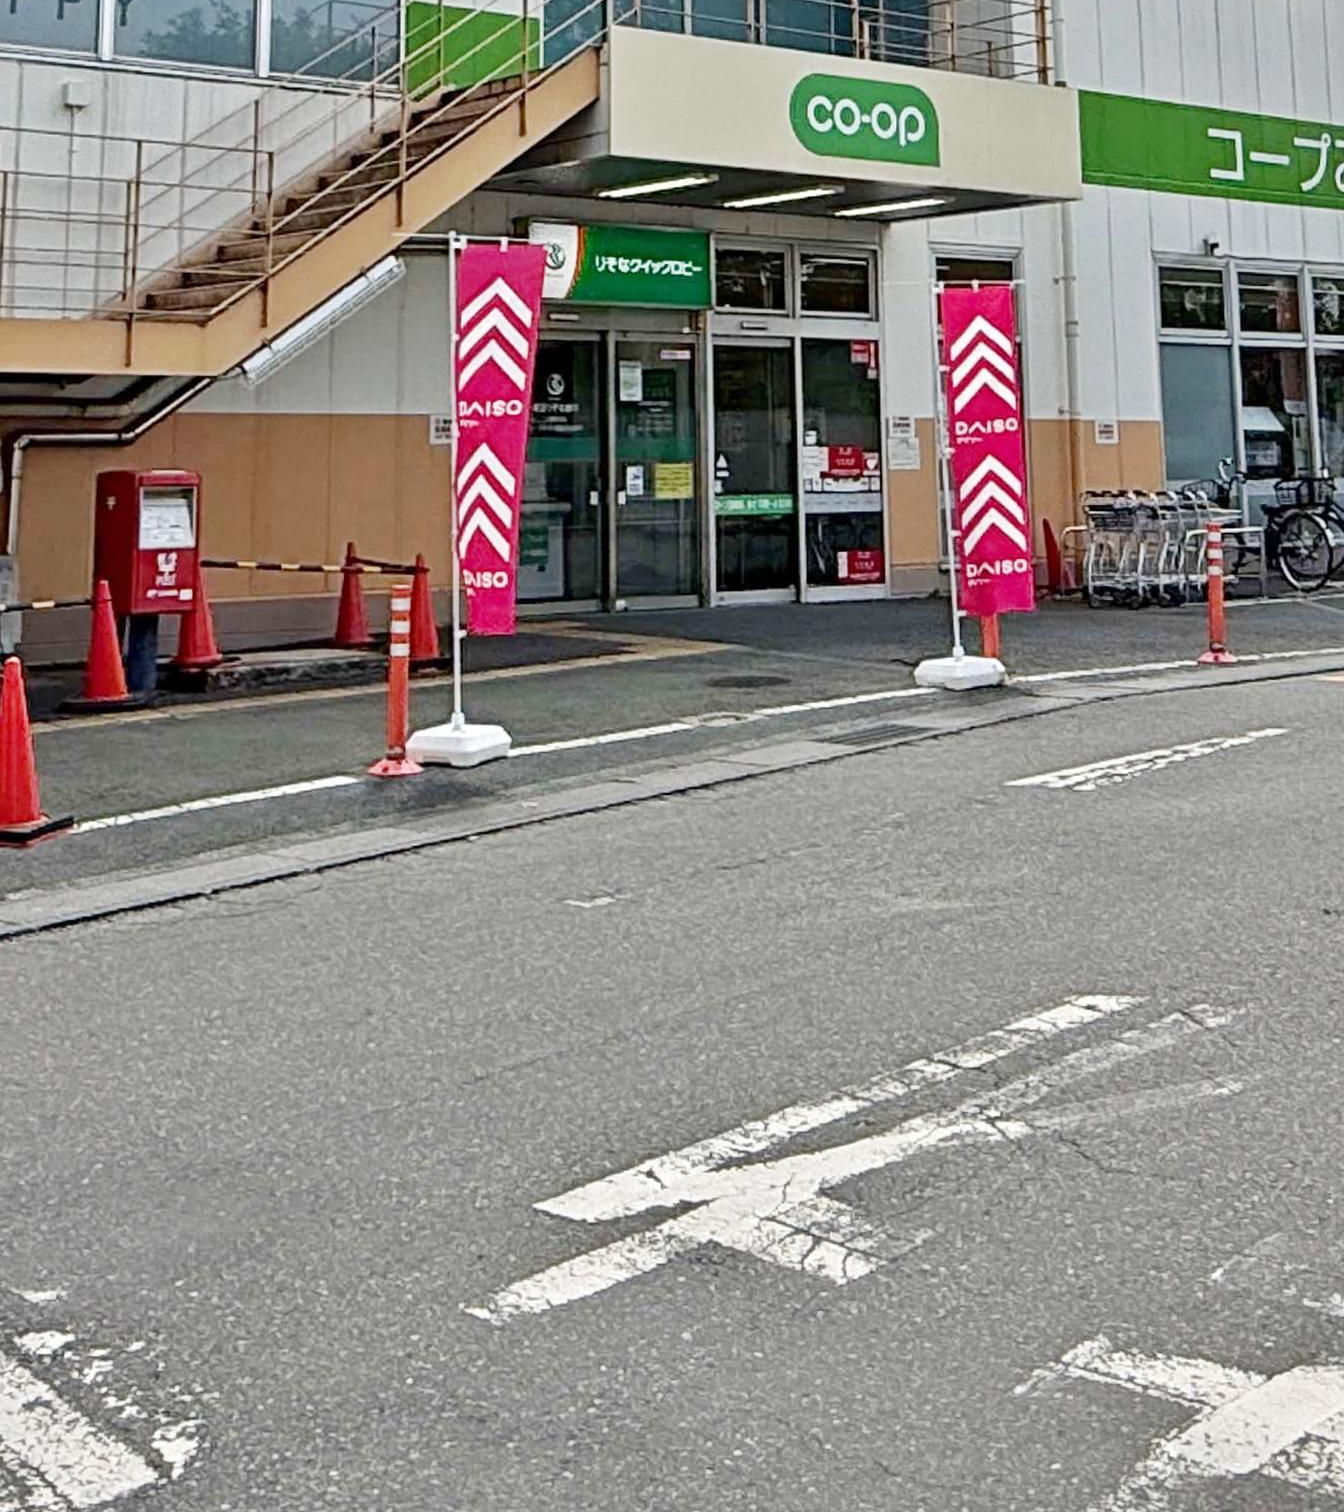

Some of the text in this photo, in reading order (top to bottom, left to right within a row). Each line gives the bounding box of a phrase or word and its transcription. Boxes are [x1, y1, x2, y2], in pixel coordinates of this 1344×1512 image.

[595, 255, 703, 277] りそなクイックロビー
[955, 417, 1018, 436] DAISO
[966, 558, 1028, 578] DAISO
